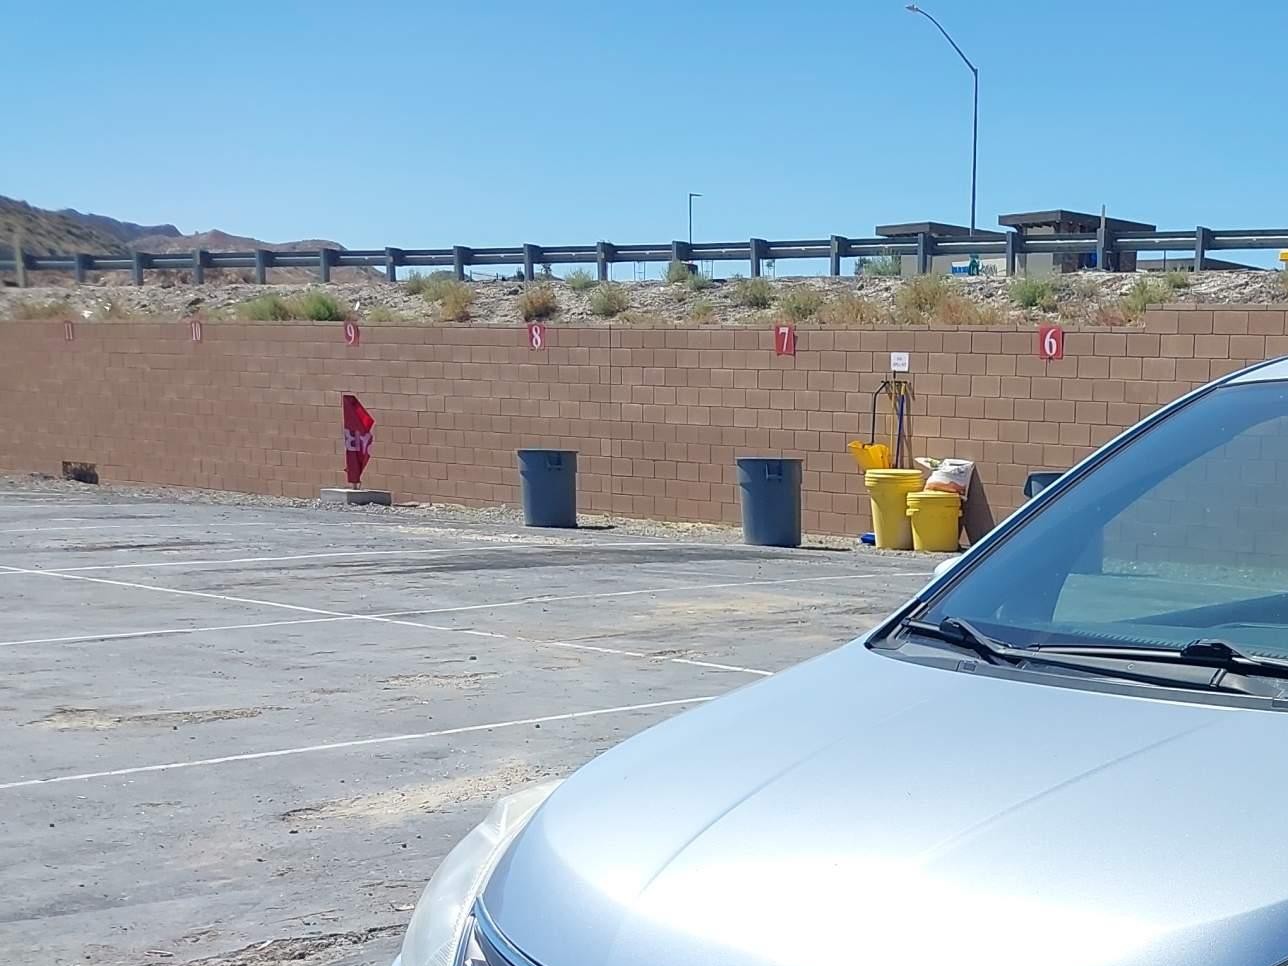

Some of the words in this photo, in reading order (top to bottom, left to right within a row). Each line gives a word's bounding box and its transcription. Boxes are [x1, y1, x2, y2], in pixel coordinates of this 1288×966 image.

[191, 322, 201, 341] 10
[346, 323, 356, 345] 9
[532, 325, 542, 348] 8
[779, 326, 789, 352] 7
[1044, 328, 1057, 355] 6
